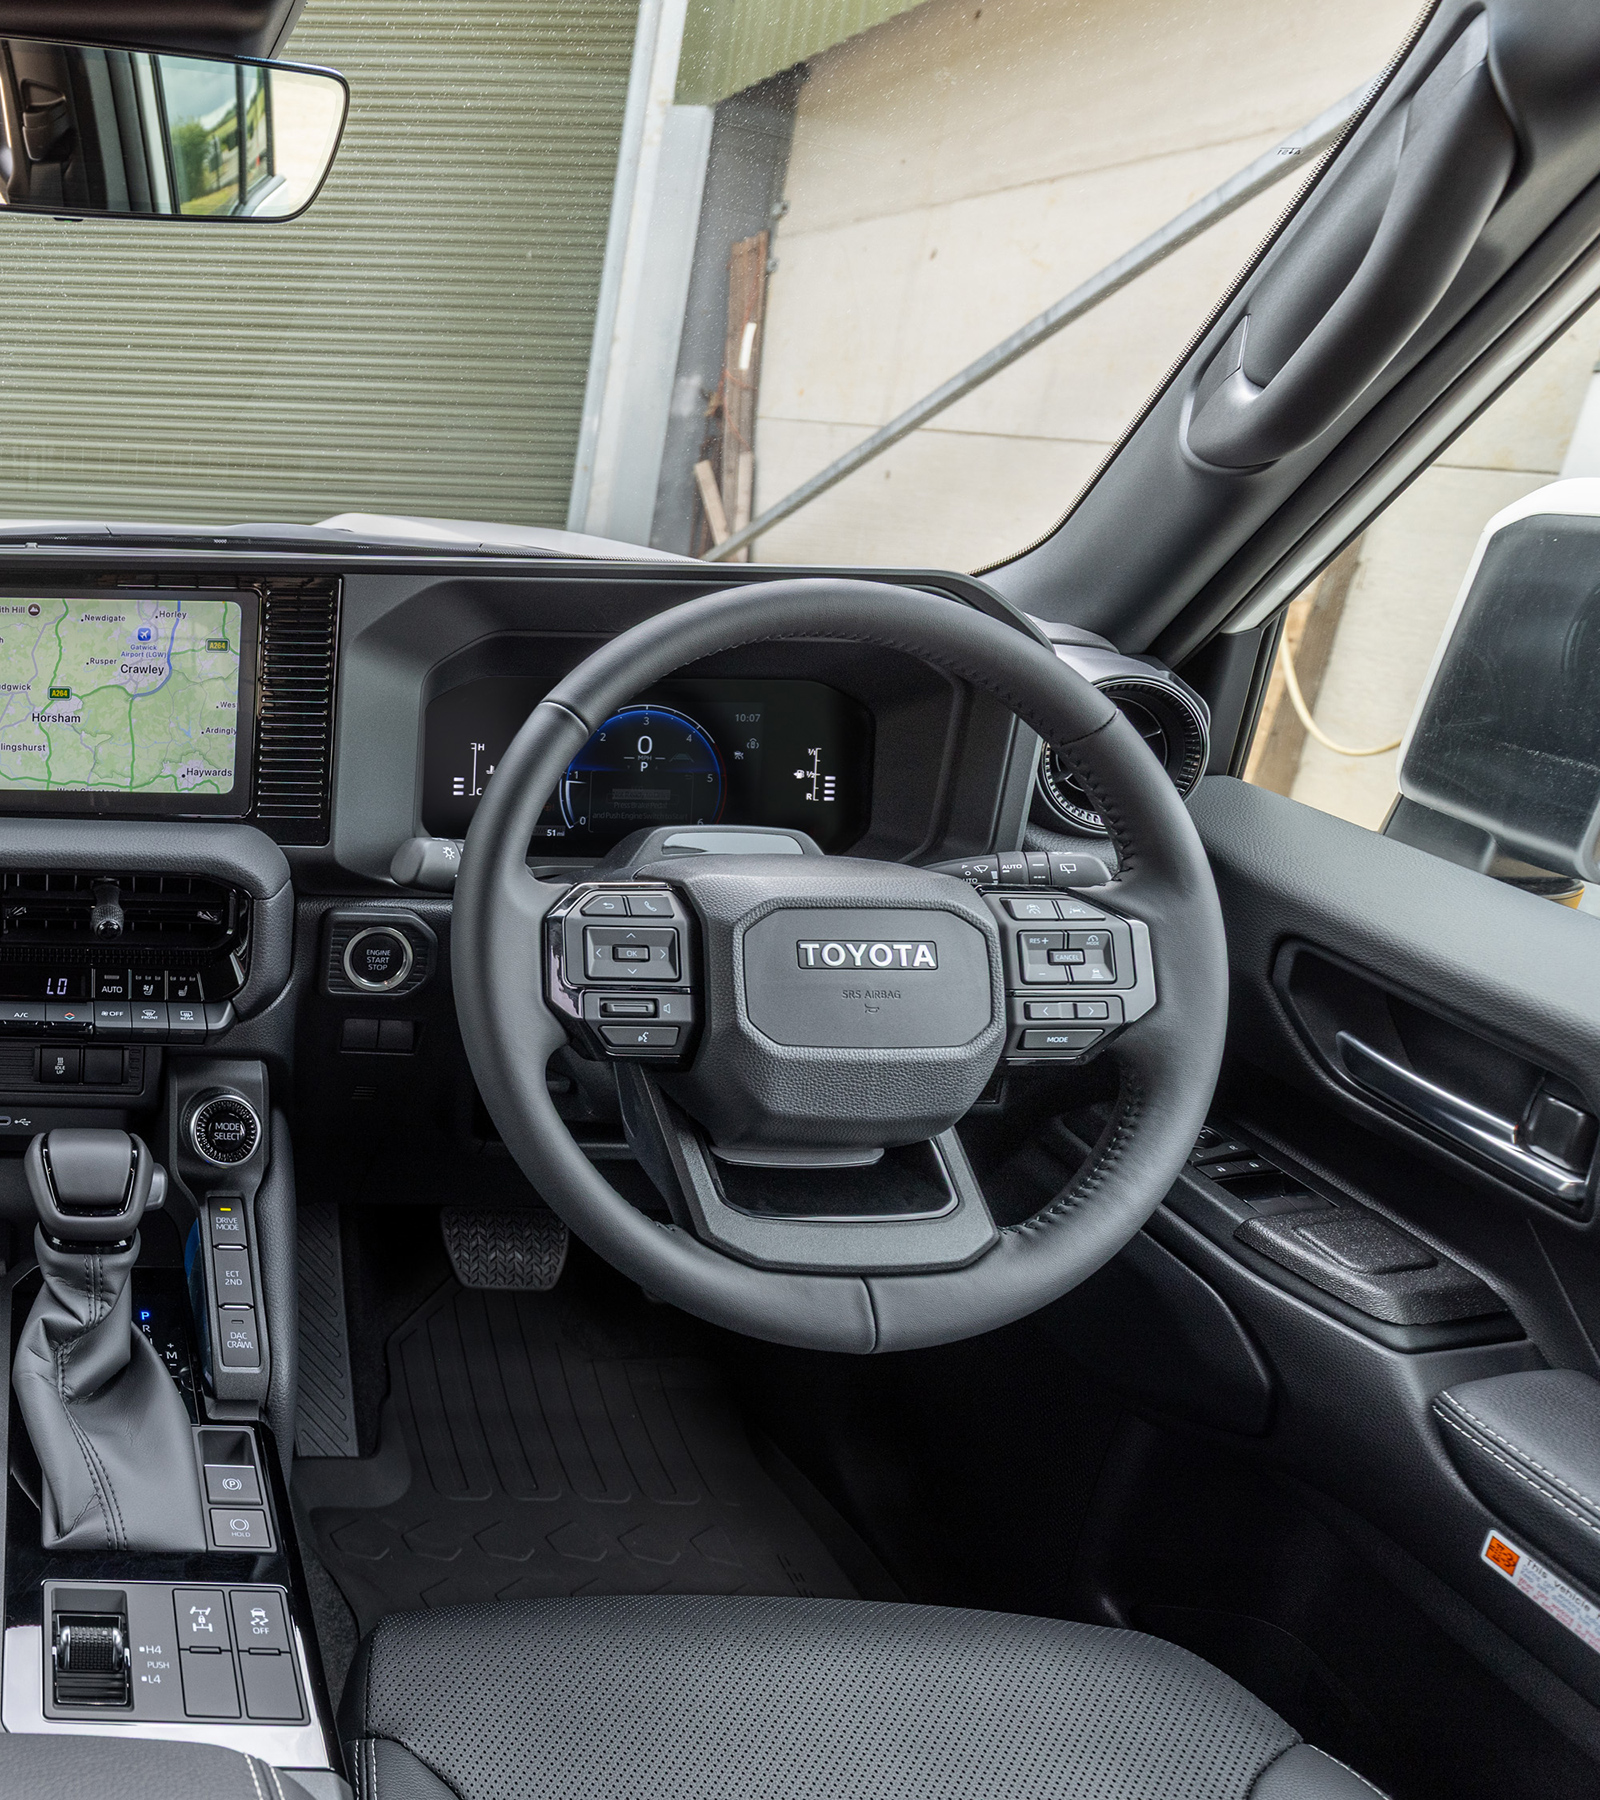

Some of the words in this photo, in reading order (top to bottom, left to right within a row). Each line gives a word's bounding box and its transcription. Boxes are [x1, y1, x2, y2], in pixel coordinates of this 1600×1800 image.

[84, 614, 125, 623] Newdigate
[160, 610, 187, 619] Horley
[120, 664, 164, 676] Crawley
[32, 714, 81, 723] Horsham
[644, 717, 650, 725] 3
[736, 714, 760, 722] 10:07
[206, 727, 237, 735] Ardingly
[600, 733, 606, 742] 2
[686, 734, 692, 742] 4
[640, 762, 648, 772] P
[186, 768, 232, 777] Haywards
[707, 774, 713, 782] 5
[580, 817, 586, 825] 0
[366, 949, 391, 957] ENGINE
[800, 943, 936, 967] TOYOTA
[46, 978, 68, 994] LO
[842, 990, 861, 999] SRS
[864, 990, 901, 999] AIRBAG
[215, 1122, 239, 1131] MODE
[214, 1132, 240, 1140] SELECT
[141, 1311, 150, 1320] P
[142, 1324, 151, 1332] R
[227, 1340, 253, 1349] CRAWL
[166, 1351, 178, 1360] M
[1527, 1558, 1548, 1579] This
[1554, 1580, 1591, 1612] vehicle
[146, 1645, 162, 1654] H4
[147, 1661, 170, 1669] PUSH
[148, 1674, 161, 1683] L4
